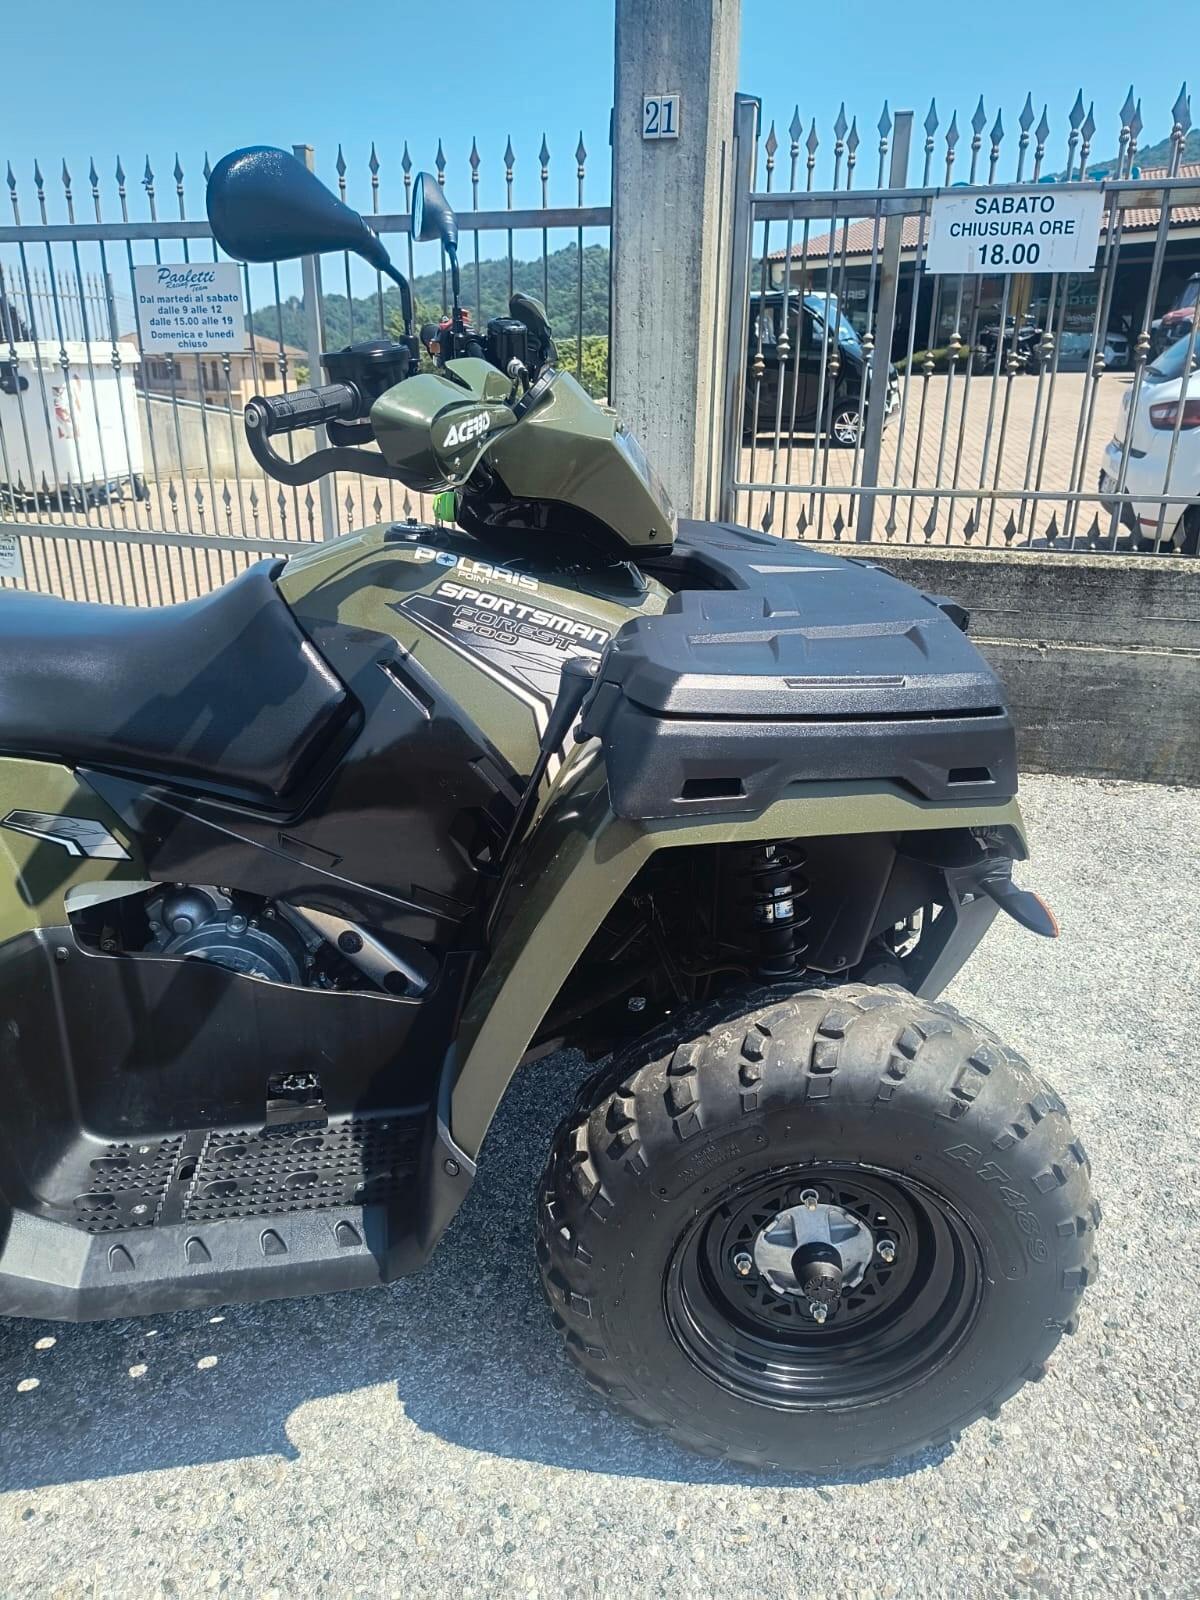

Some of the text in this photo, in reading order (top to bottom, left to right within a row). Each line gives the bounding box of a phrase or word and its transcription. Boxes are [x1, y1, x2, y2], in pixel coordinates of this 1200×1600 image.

[645, 101, 676, 133] 21
[974, 195, 1055, 215] SABATO
[950, 220, 1075, 237] CHIUSURA ORE
[978, 243, 1041, 265] 18.00
[157, 267, 216, 284] Paoletti
[140, 295, 154, 304] Dal
[195, 293, 204, 303] al
[206, 293, 239, 302] sabato
[158, 305, 222, 315] dalle 9 alle 12
[149, 316, 233, 326] dalle 15.00 alle 19
[151, 331, 195, 340] Domenica
[178, 340, 208, 348] chiuso
[414, 546, 540, 592] POLARIS
[457, 571, 493, 585] POINT
[436, 582, 610, 645] SPORTSMAN
[453, 605, 578, 650] FOREST
